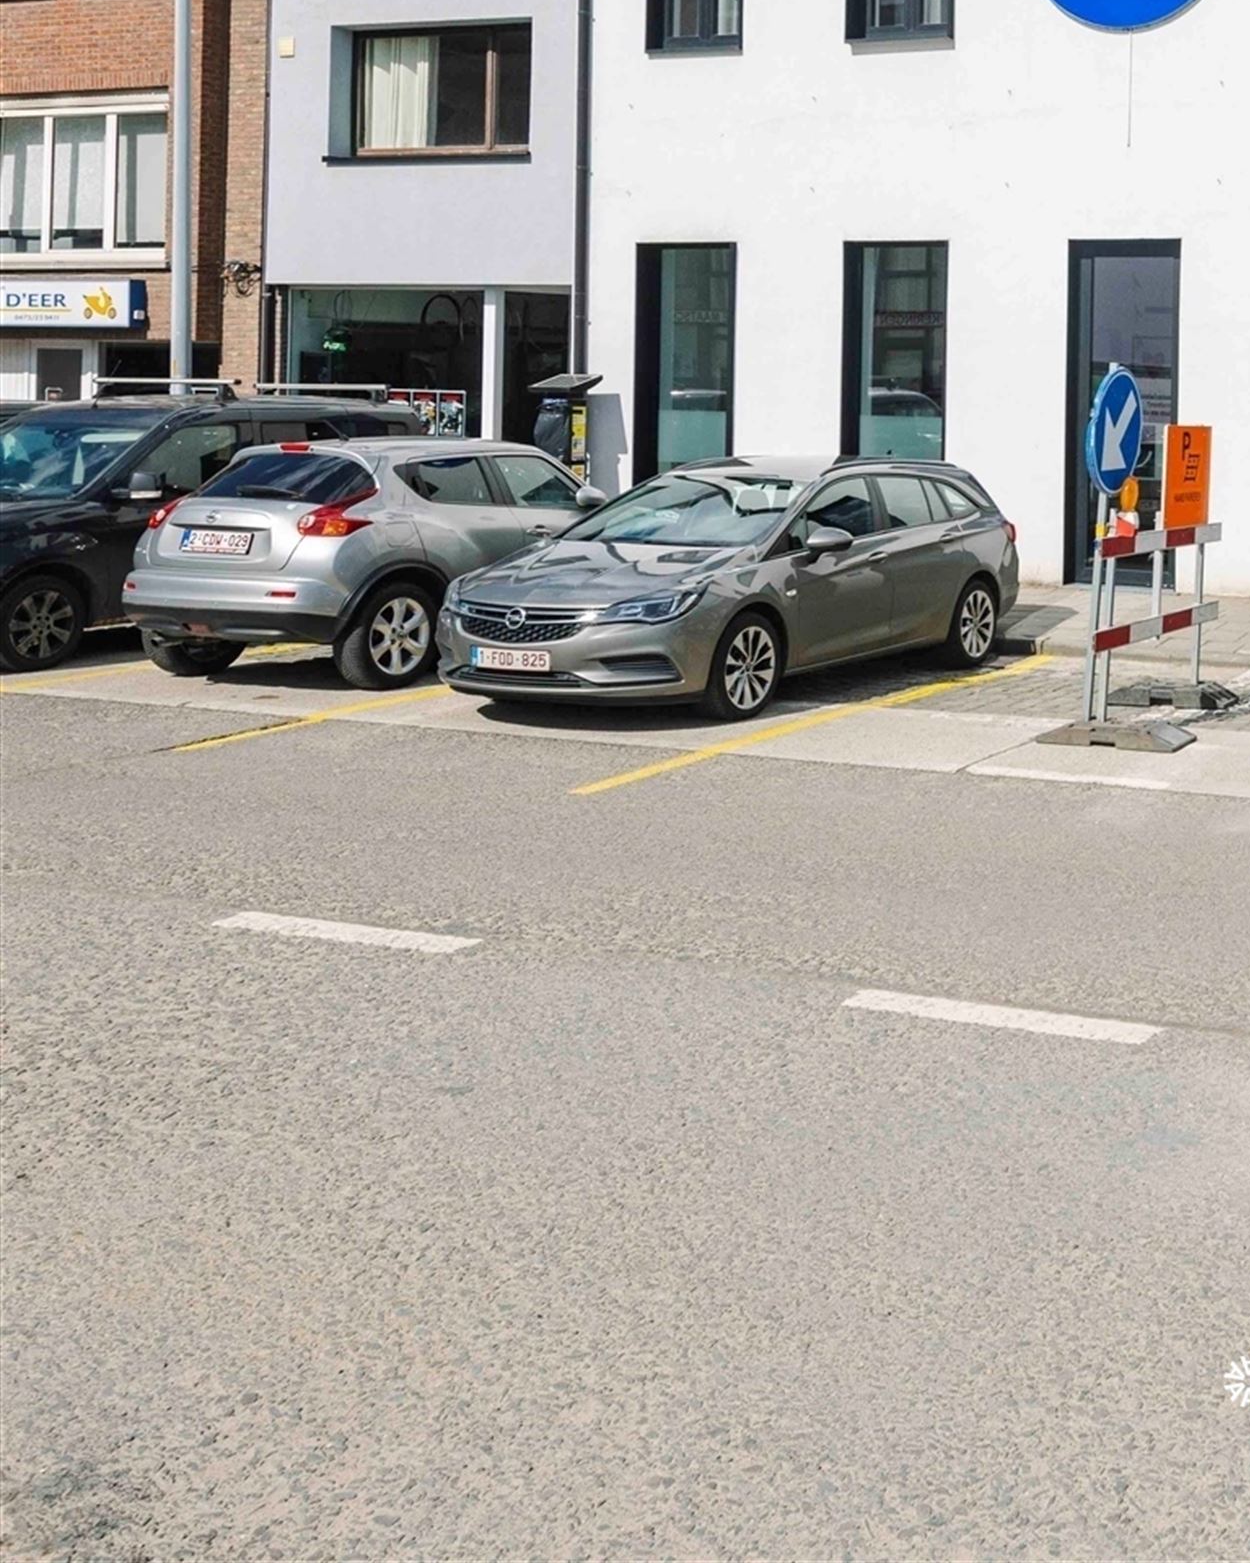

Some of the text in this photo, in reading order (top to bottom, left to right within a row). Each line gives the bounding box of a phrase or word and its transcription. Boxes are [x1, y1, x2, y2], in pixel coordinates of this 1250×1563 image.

[6, 293, 67, 308] D'EER
[1182, 431, 1192, 462] P
[480, 649, 547, 668] 1-FOD-825
